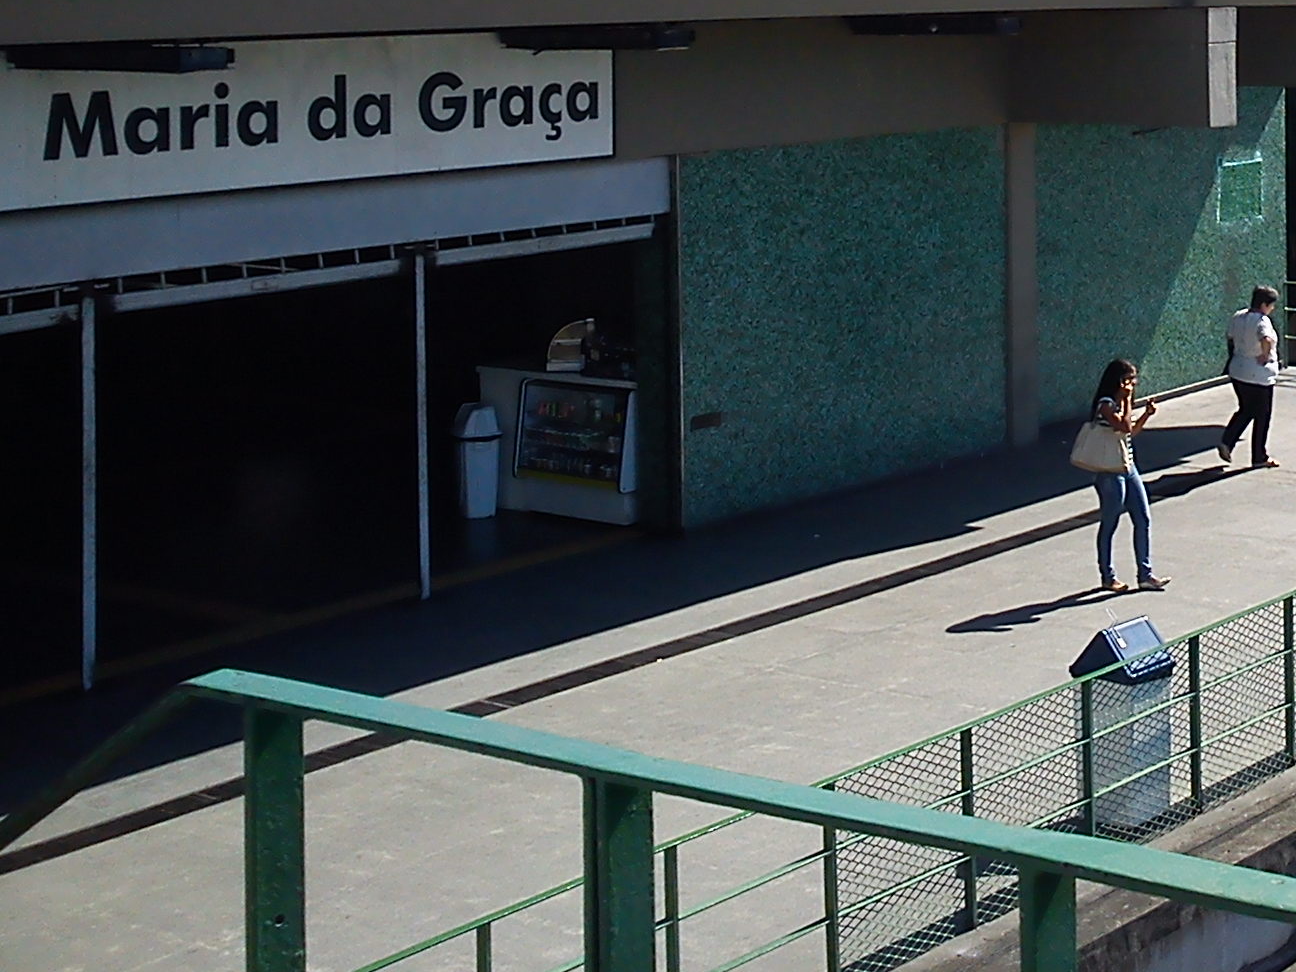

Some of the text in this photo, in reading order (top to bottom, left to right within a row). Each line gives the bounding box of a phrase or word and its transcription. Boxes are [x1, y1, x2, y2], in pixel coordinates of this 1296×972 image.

[43, 72, 598, 161] Maria da Graça
